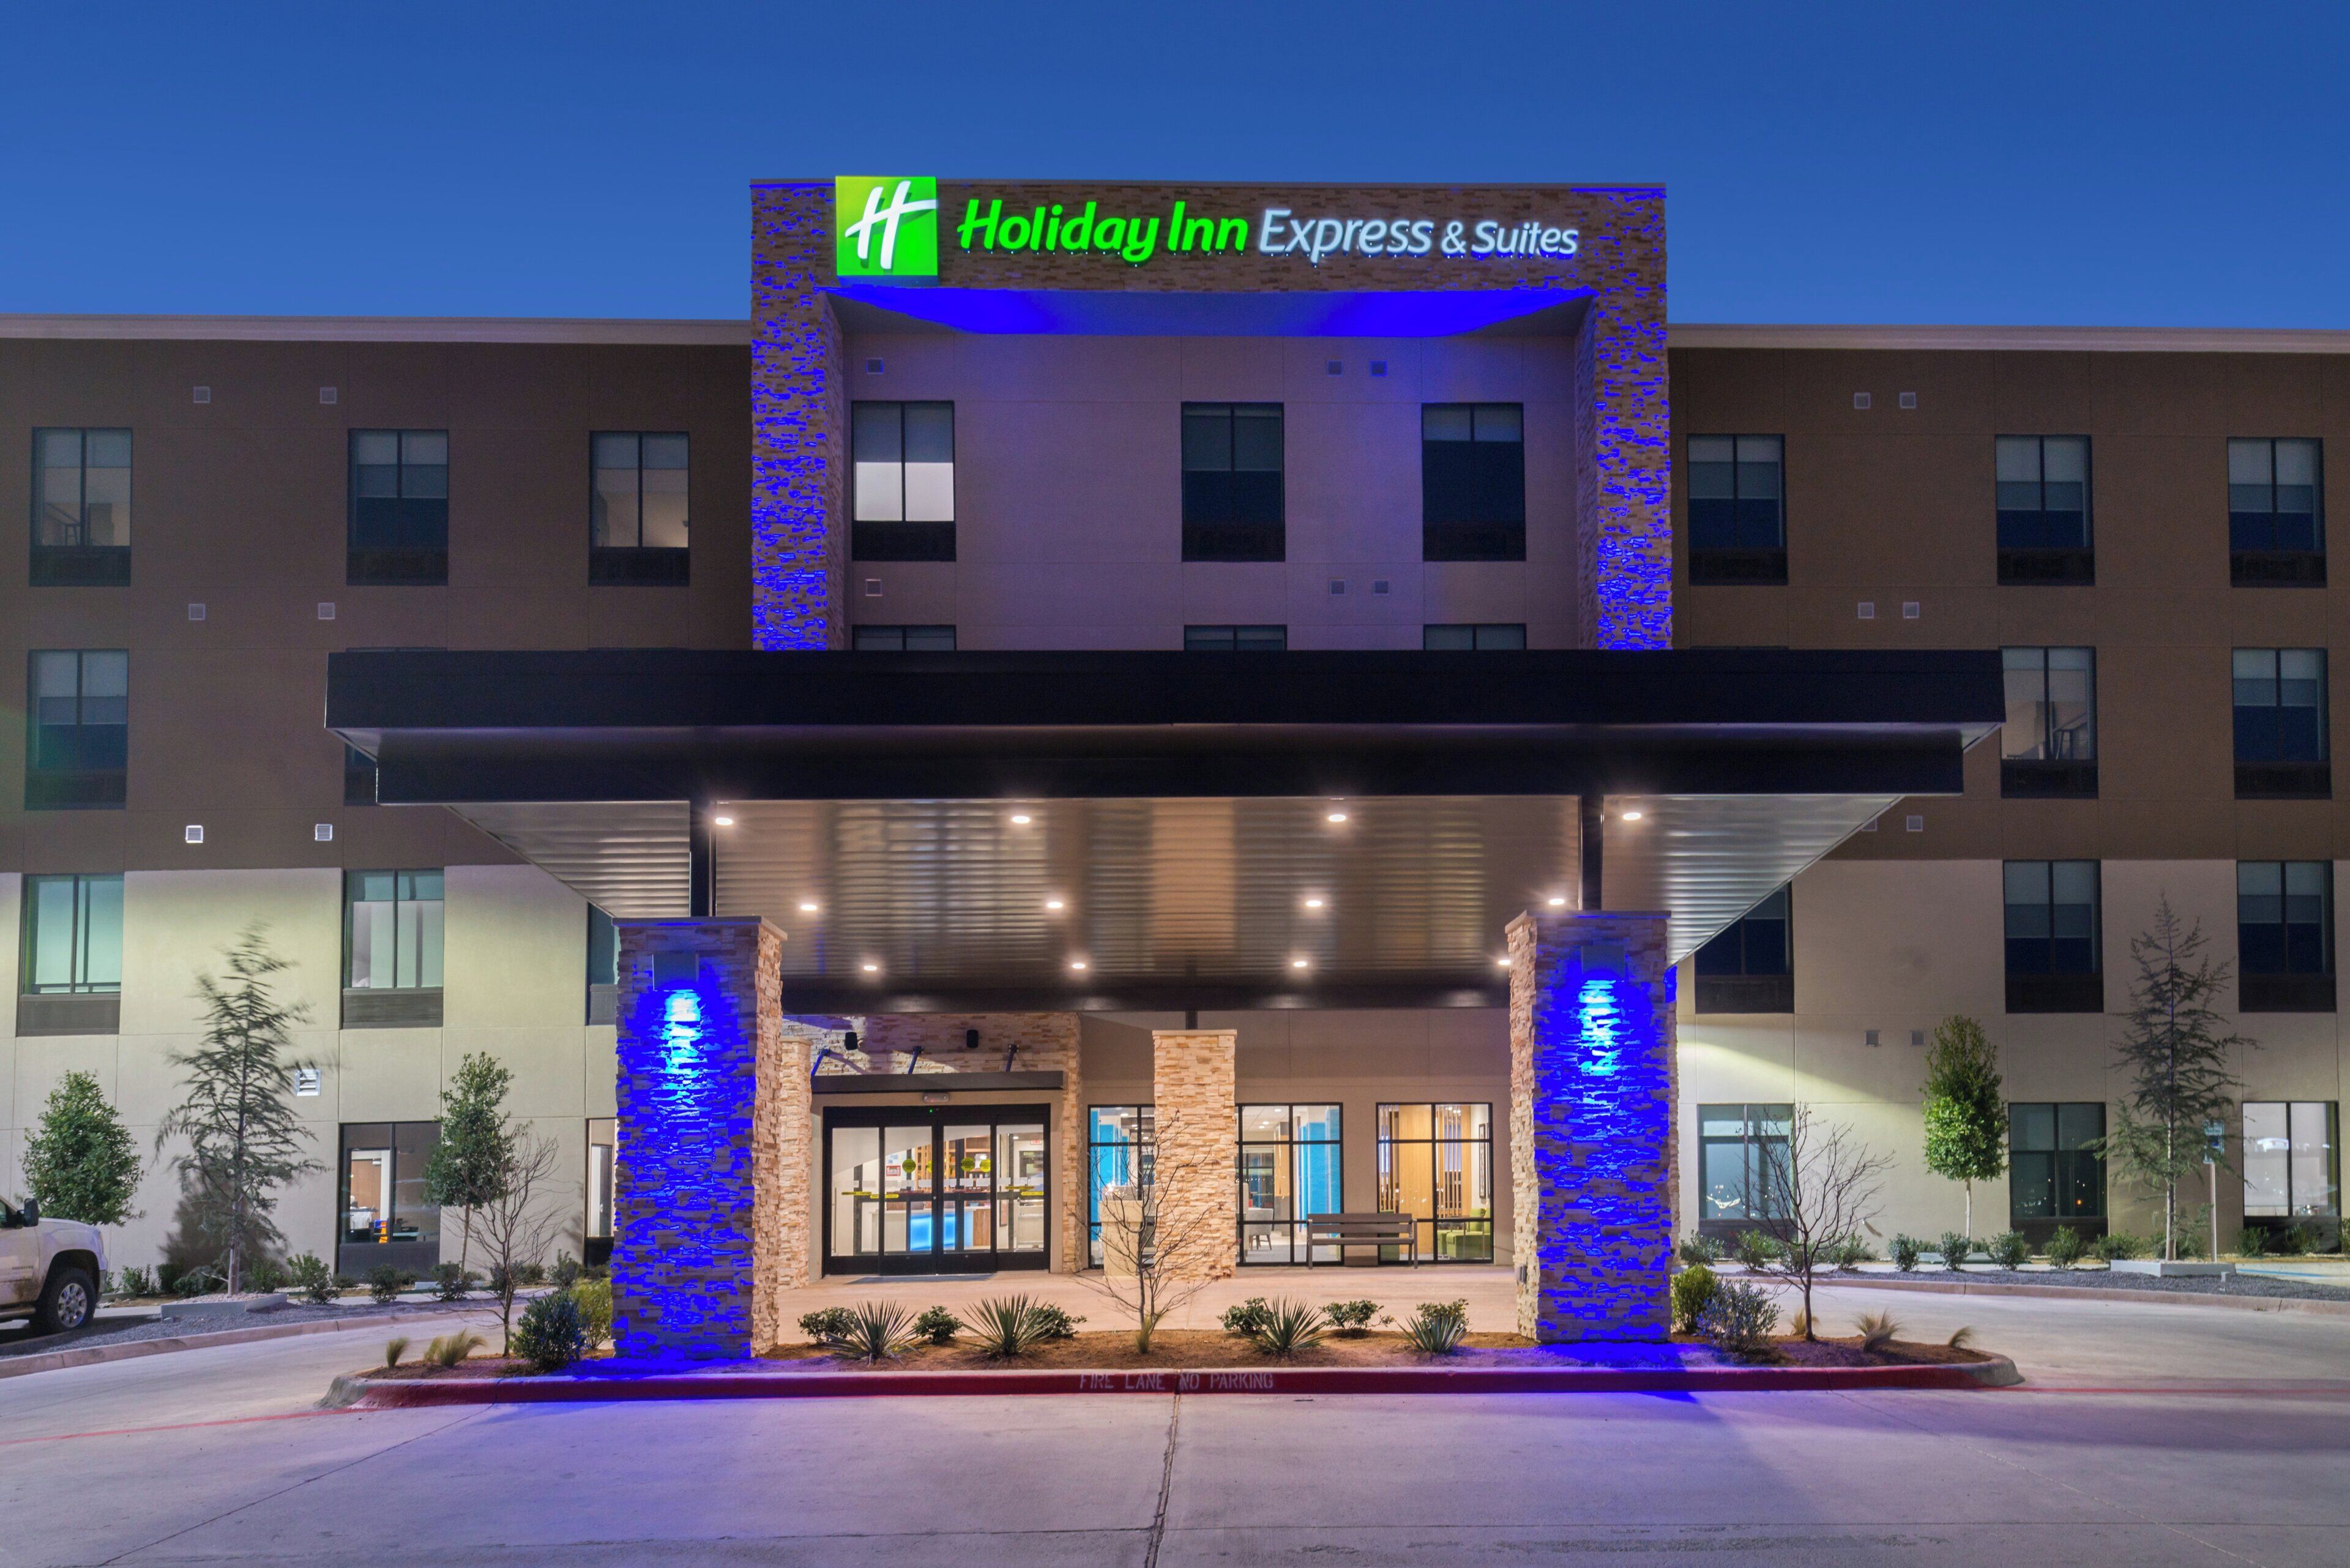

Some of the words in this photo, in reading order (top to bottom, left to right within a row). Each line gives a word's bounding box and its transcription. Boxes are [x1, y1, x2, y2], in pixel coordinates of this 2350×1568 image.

[845, 181, 938, 269] H
[957, 199, 1160, 262] Holiday
[1167, 201, 1248, 252] Inn
[1258, 208, 1434, 264] Express
[1441, 221, 1466, 254] &
[1471, 221, 1579, 255] Suites
[1080, 1374, 1114, 1389] FIRE
[1125, 1373, 1165, 1389] LANE
[1179, 1373, 1199, 1390] NO
[1210, 1373, 1274, 1389] PARKING
